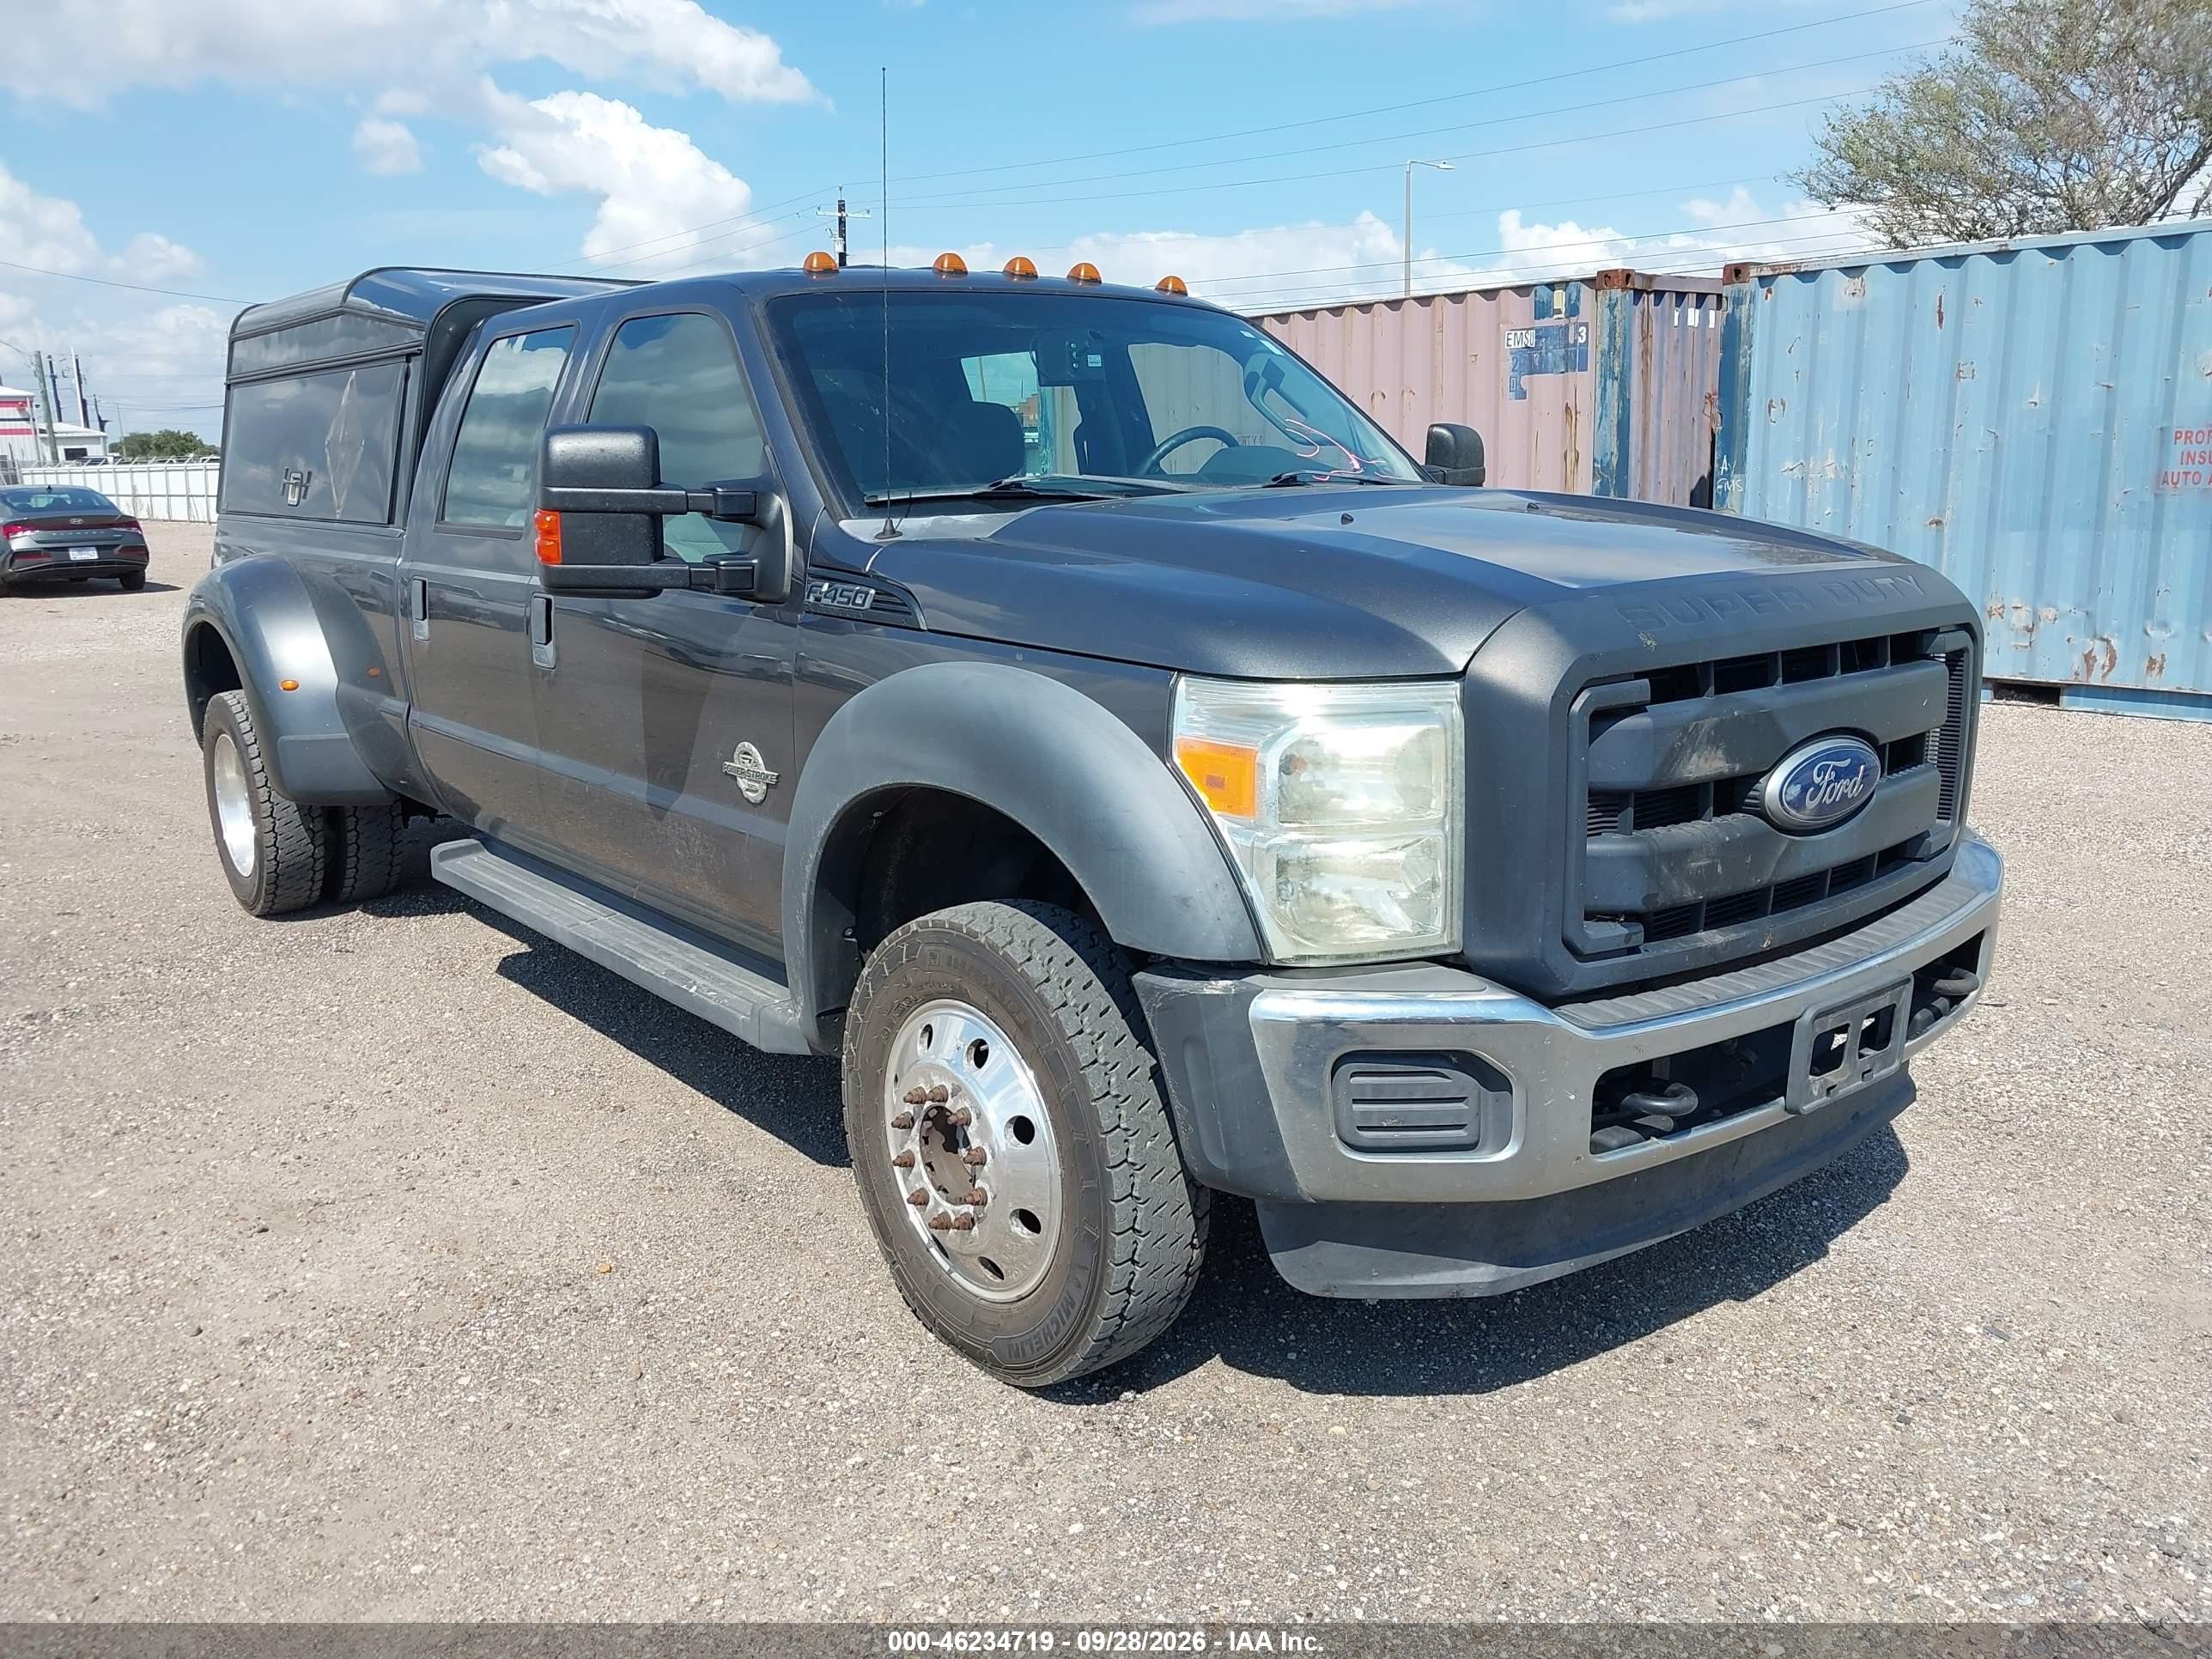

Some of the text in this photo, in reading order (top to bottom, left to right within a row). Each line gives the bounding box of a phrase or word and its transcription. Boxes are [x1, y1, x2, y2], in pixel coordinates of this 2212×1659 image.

[1506, 331, 1534, 347] EMSU
[2161, 471, 2202, 486] AUTO
[1614, 574, 1928, 631] SUPER DUTY
[1805, 758, 1865, 810] Ford
[1007, 1291, 1077, 1361] MICHELIN
